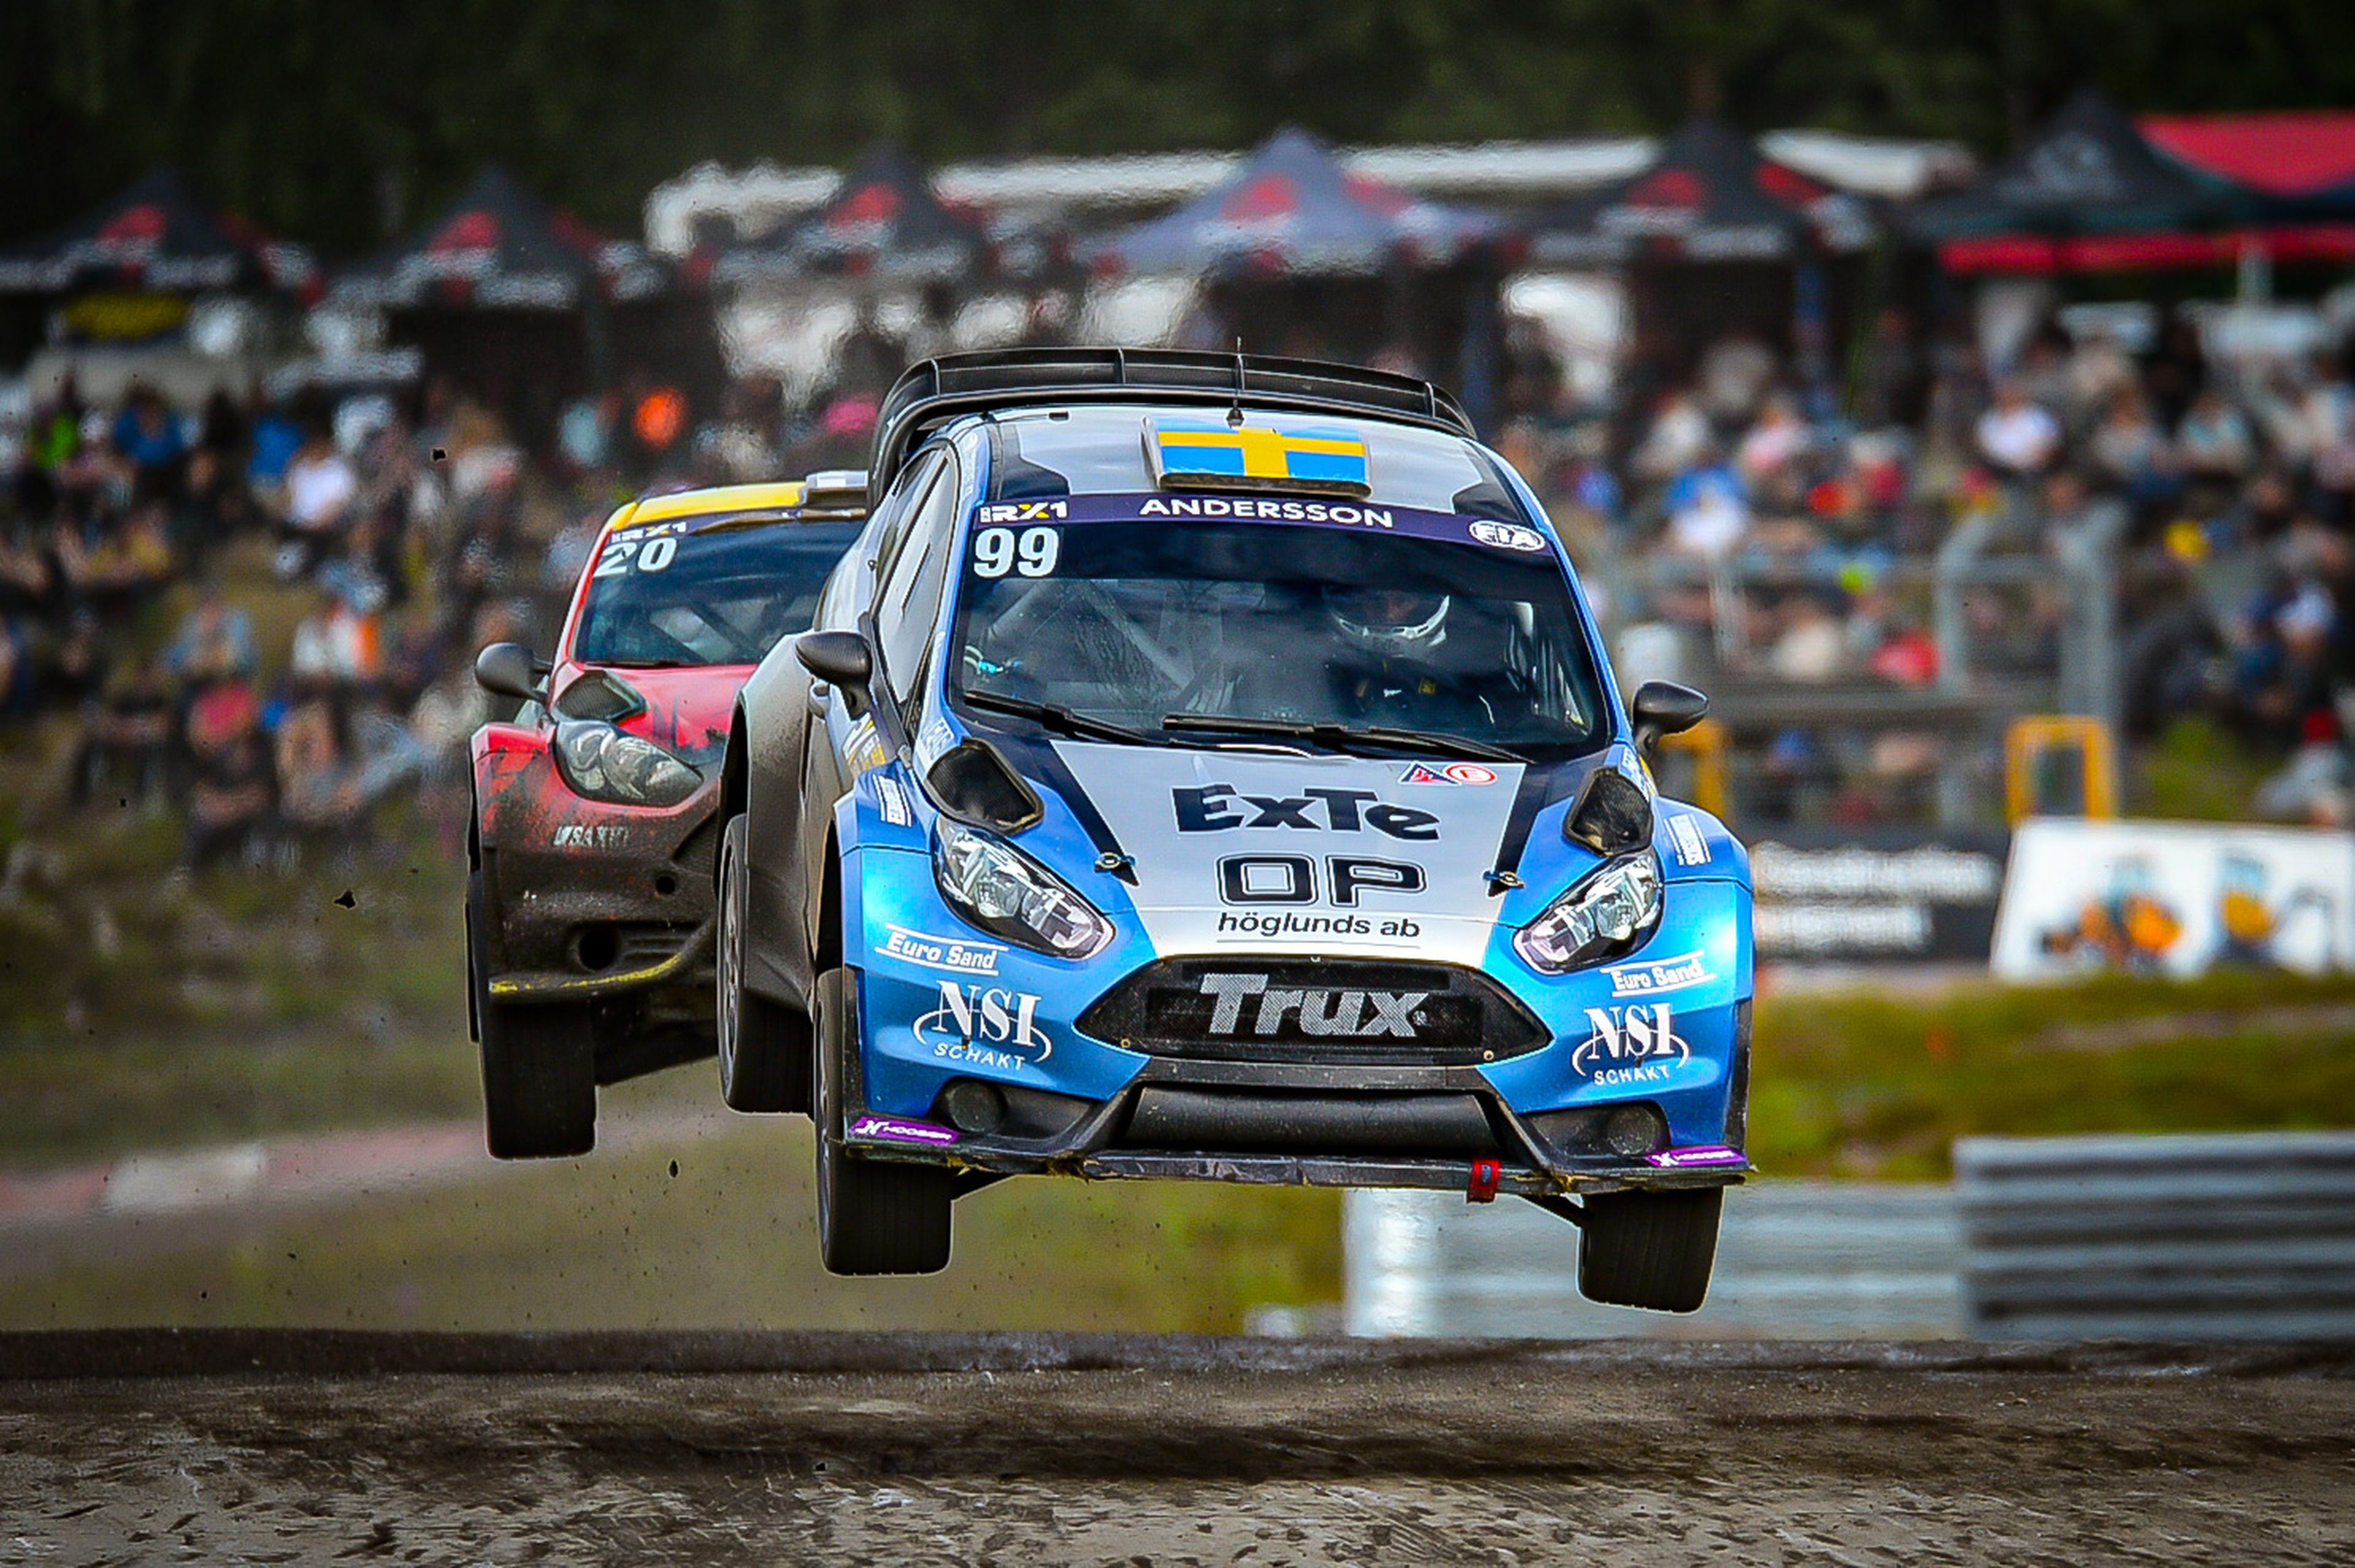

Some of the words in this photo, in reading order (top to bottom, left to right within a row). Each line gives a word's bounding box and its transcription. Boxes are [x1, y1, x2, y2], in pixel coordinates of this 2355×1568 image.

[1139, 499, 1393, 529] ANDERSSON
[1474, 522, 1536, 546] FIA
[593, 537, 677, 578] 20
[973, 527, 1059, 578] 99
[1171, 783, 1440, 841] ExTe
[1216, 853, 1428, 908] OP
[1218, 912, 1371, 937] höglunds
[1379, 918, 1420, 938] ab
[887, 931, 941, 962] Euro
[946, 946, 998, 970] Sand
[1611, 969, 1651, 992] Euro
[1652, 957, 1704, 986] Sand
[930, 980, 1042, 1047] NSI
[1200, 974, 1430, 1038] Trux
[1583, 1003, 1675, 1060] NSI
[933, 1041, 1026, 1071] SCHAKT
[1594, 1065, 1670, 1086] SCHAKT
